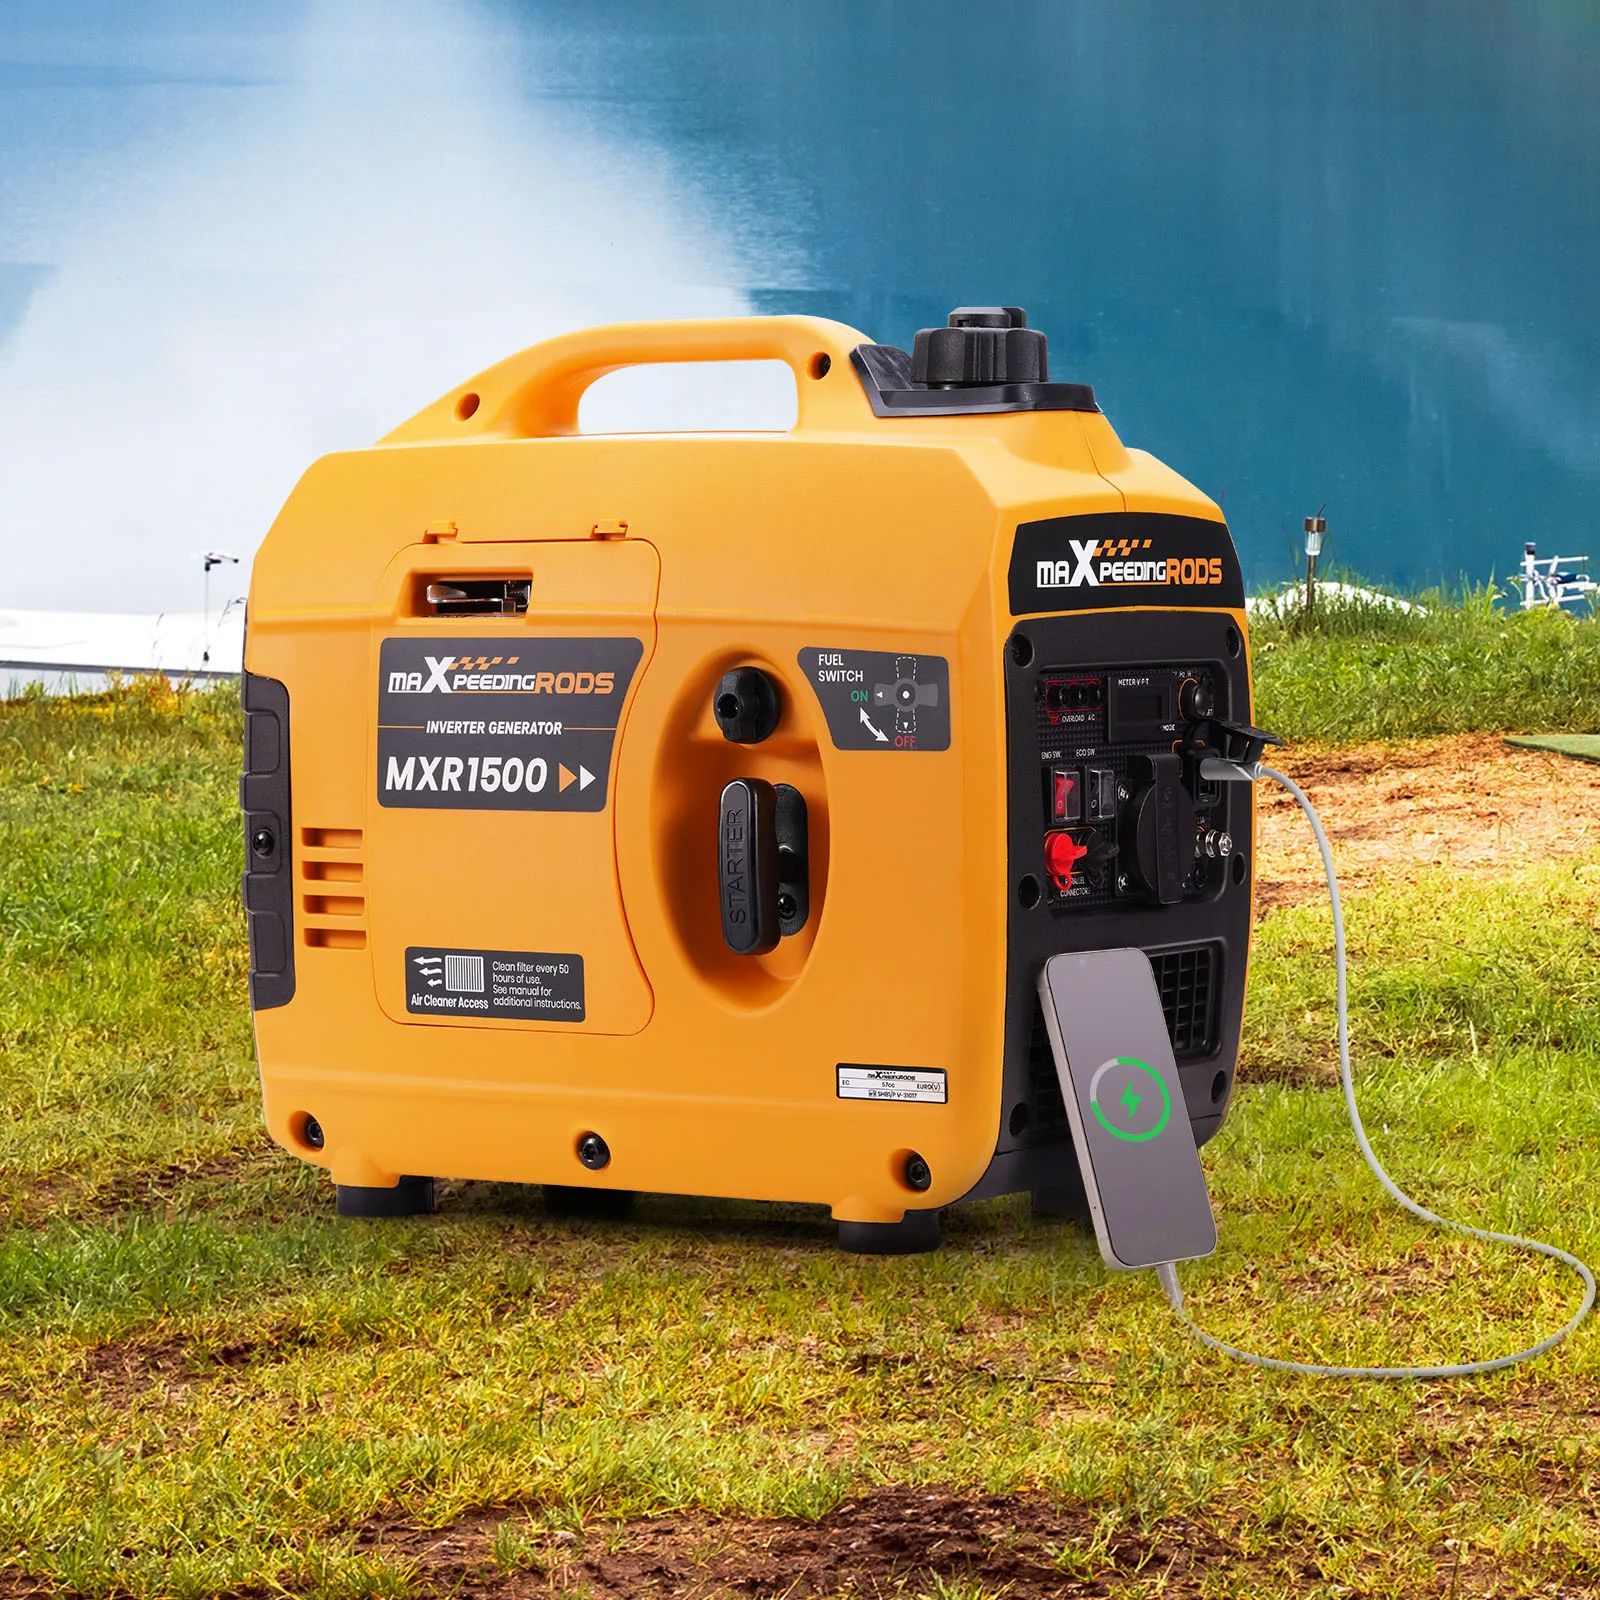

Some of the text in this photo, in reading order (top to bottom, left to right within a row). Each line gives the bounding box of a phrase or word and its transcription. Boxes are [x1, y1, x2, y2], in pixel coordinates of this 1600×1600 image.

[818, 653, 844, 666] FUEL
[818, 669, 864, 682] SWITCH
[850, 690, 869, 702] ON
[1061, 714, 1085, 723] OVERLOAD
[426, 720, 562, 735] INVERTER GENERATOR
[894, 735, 916, 748] OFF
[1075, 748, 1087, 757] ECO
[385, 756, 548, 792] MXR1500
[726, 808, 746, 925] STARTER
[492, 961, 569, 976] Clean filter every 50
[492, 973, 542, 985] hours of use.
[492, 984, 552, 997] See manual for
[411, 993, 489, 1009] Air Cleaner Access
[493, 997, 582, 1010] additional instructions.
[881, 1081, 895, 1089] 57cc
